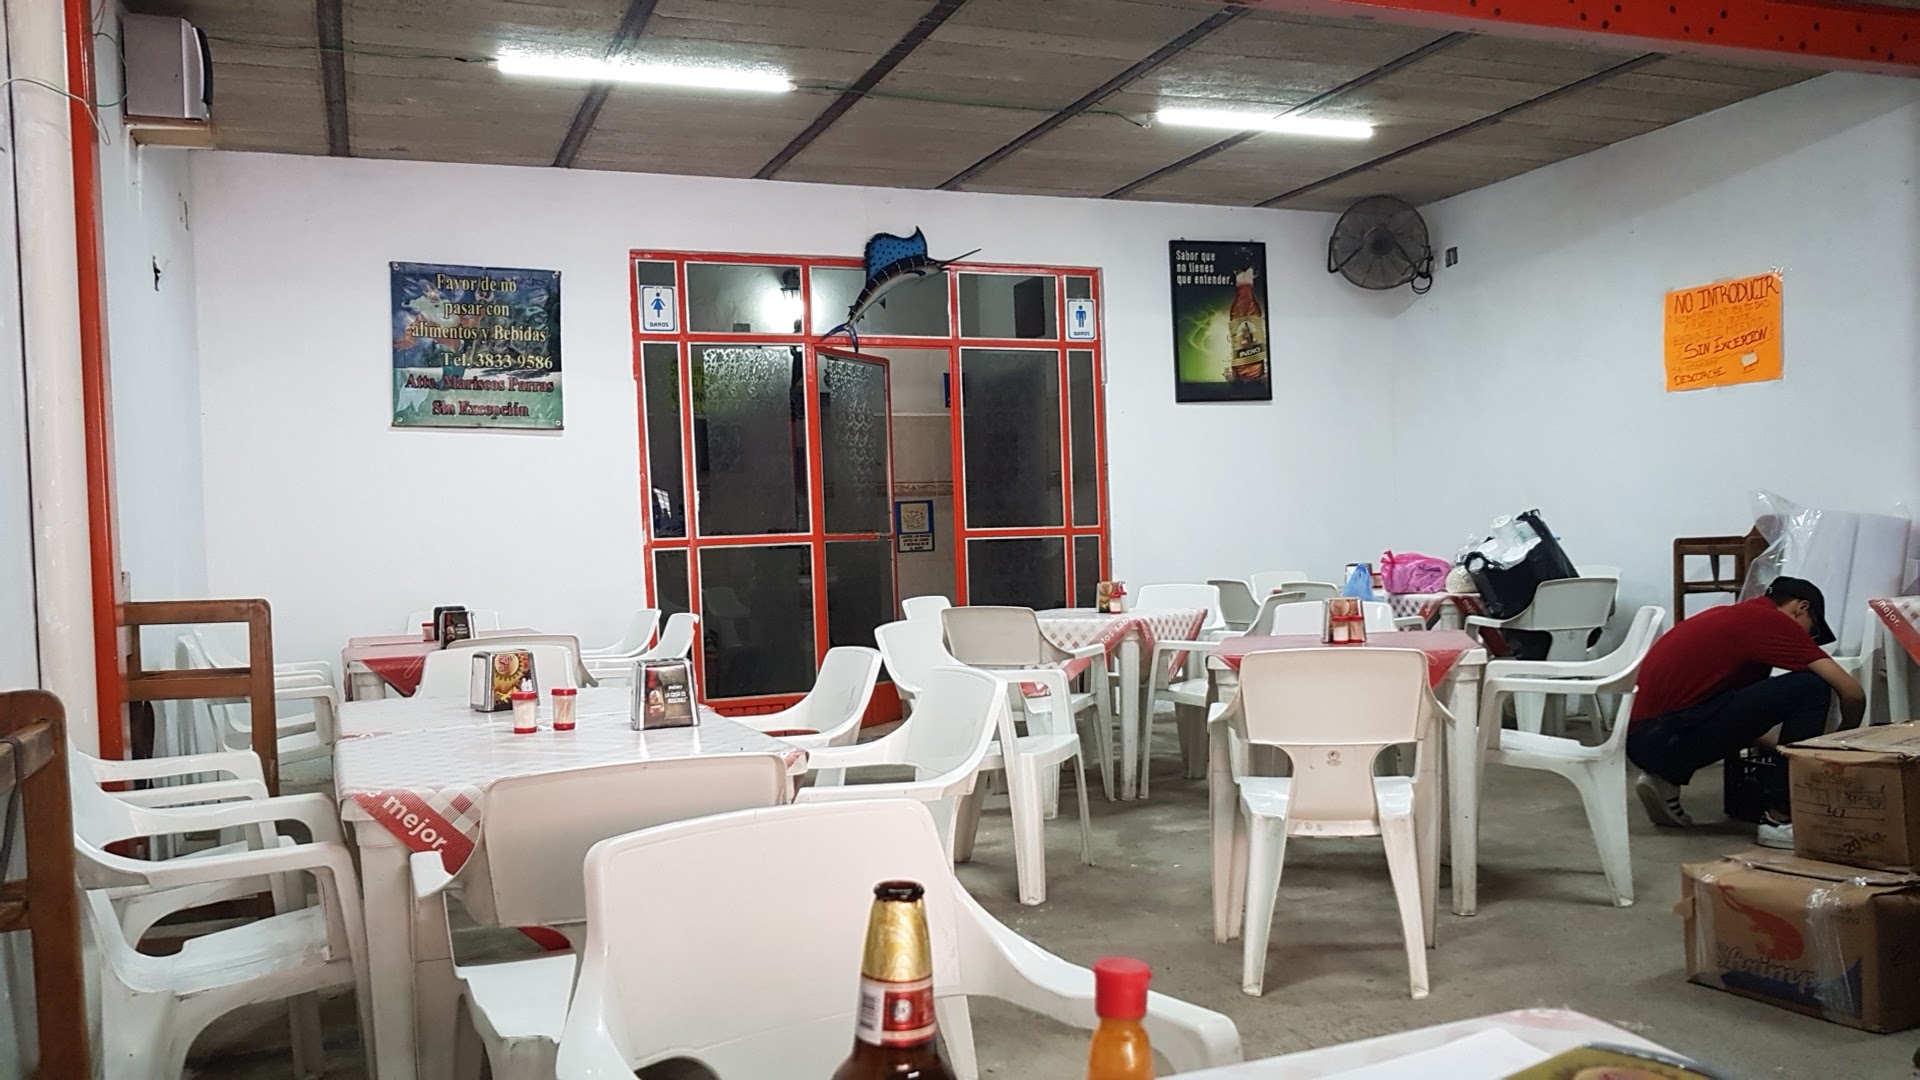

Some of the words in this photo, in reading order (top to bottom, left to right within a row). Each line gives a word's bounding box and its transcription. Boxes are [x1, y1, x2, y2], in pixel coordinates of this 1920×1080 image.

[1176, 250, 1198, 261] Sabor
[1201, 251, 1216, 263] que
[1176, 263, 1187, 273] no
[1189, 262, 1214, 273] tienes
[436, 273, 478, 291] Favor
[481, 276, 497, 291] de
[500, 280, 518, 293] no
[1177, 276, 1192, 286] que
[1194, 274, 1234, 285] entender.
[1674, 292, 1694, 315] NO
[1697, 275, 1780, 311] INTRODUCIR
[444, 302, 482, 319] pasar
[486, 304, 510, 316] con
[411, 321, 478, 340] alimentos
[482, 328, 490, 343] y
[494, 325, 546, 342] Bebidas
[1684, 343, 1711, 360] SIN
[441, 352, 471, 367] Tel.
[476, 353, 512, 368] 3833
[516, 355, 553, 370] 9586
[405, 374, 439, 389] Atte.
[443, 375, 505, 391] Mariscos
[508, 377, 554, 392] Parras
[432, 400, 456, 415] Sin
[458, 401, 529, 419] Excepción
